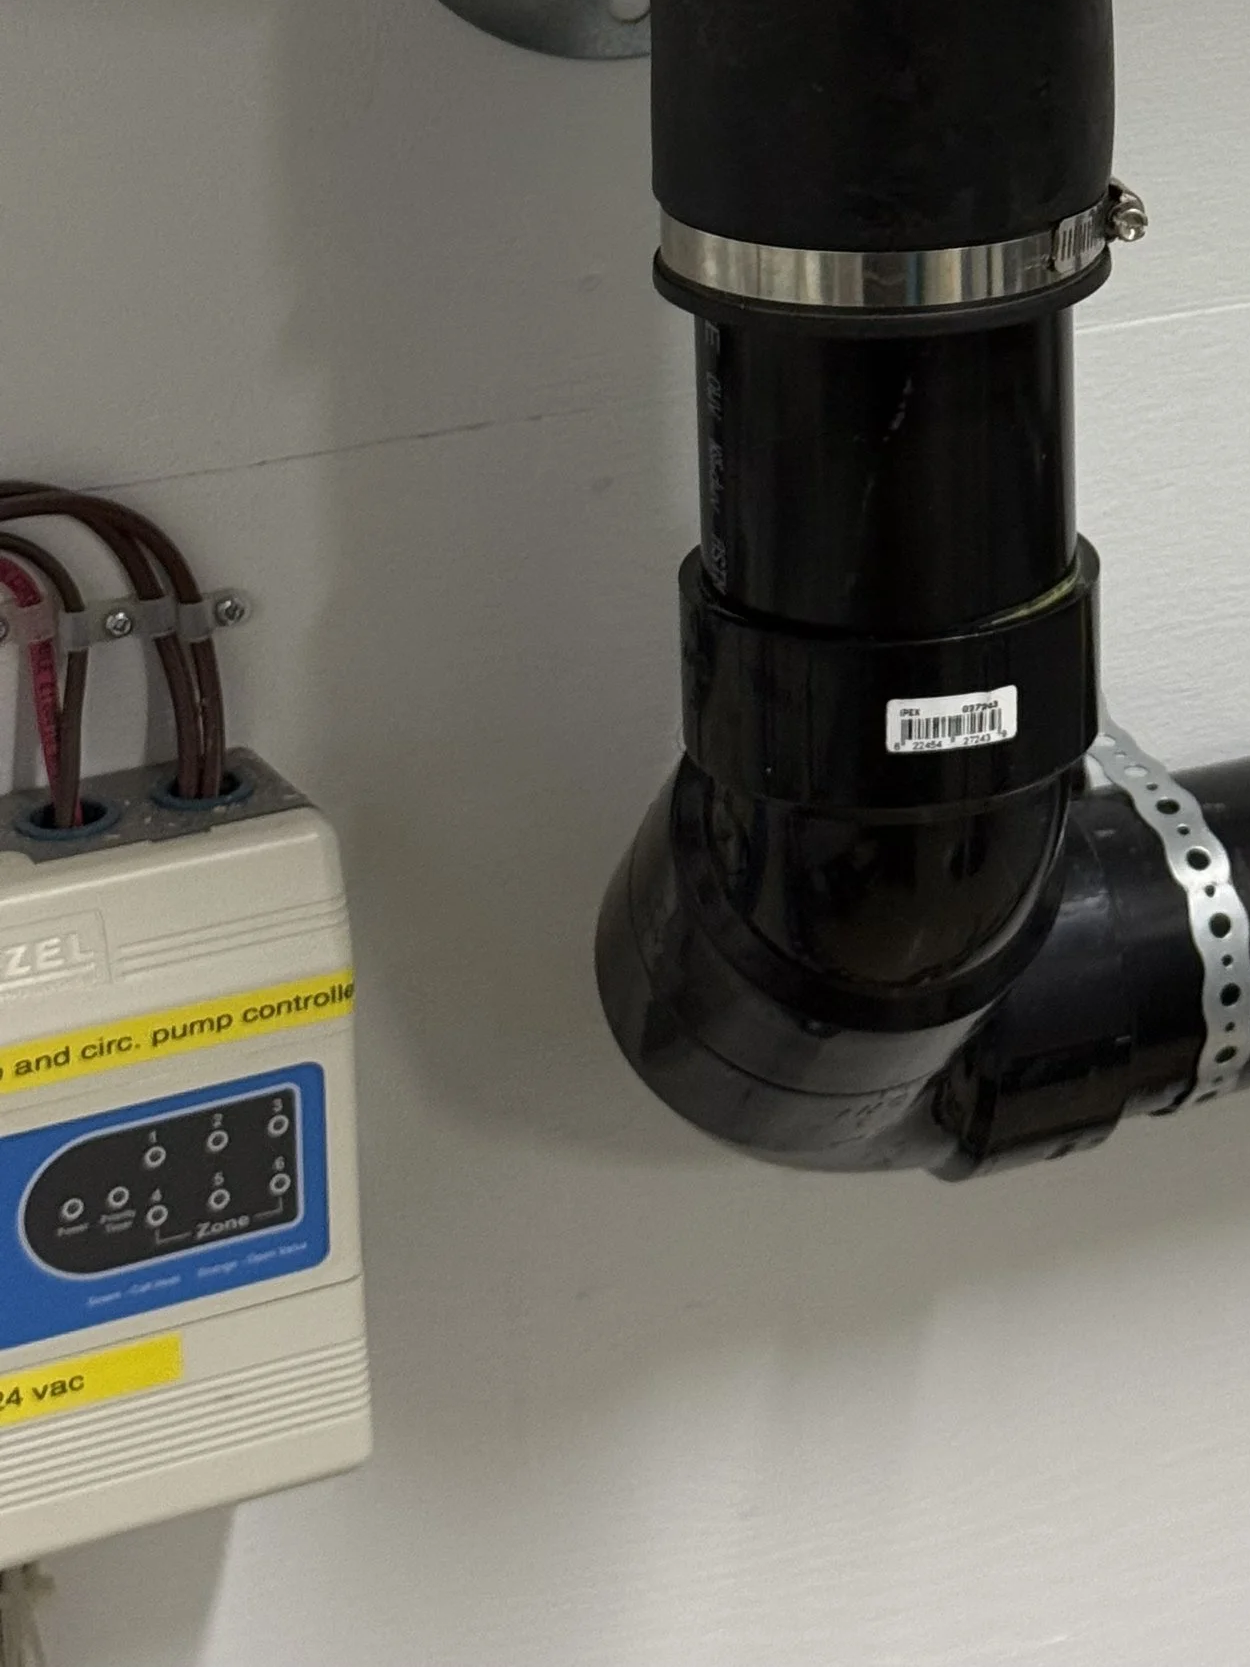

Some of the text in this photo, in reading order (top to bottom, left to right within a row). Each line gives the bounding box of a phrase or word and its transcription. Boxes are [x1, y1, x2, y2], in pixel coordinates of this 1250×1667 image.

[963, 734, 991, 745] 27243
[14, 1045, 70, 1077] and
[81, 1032, 141, 1061] circ.
[151, 1010, 232, 1048] pump
[149, 1098, 283, 1144] 1 2 3
[151, 1156, 285, 1202] 4 5 6
[196, 1213, 250, 1239] Zone
[32, 1375, 85, 1400] vac
